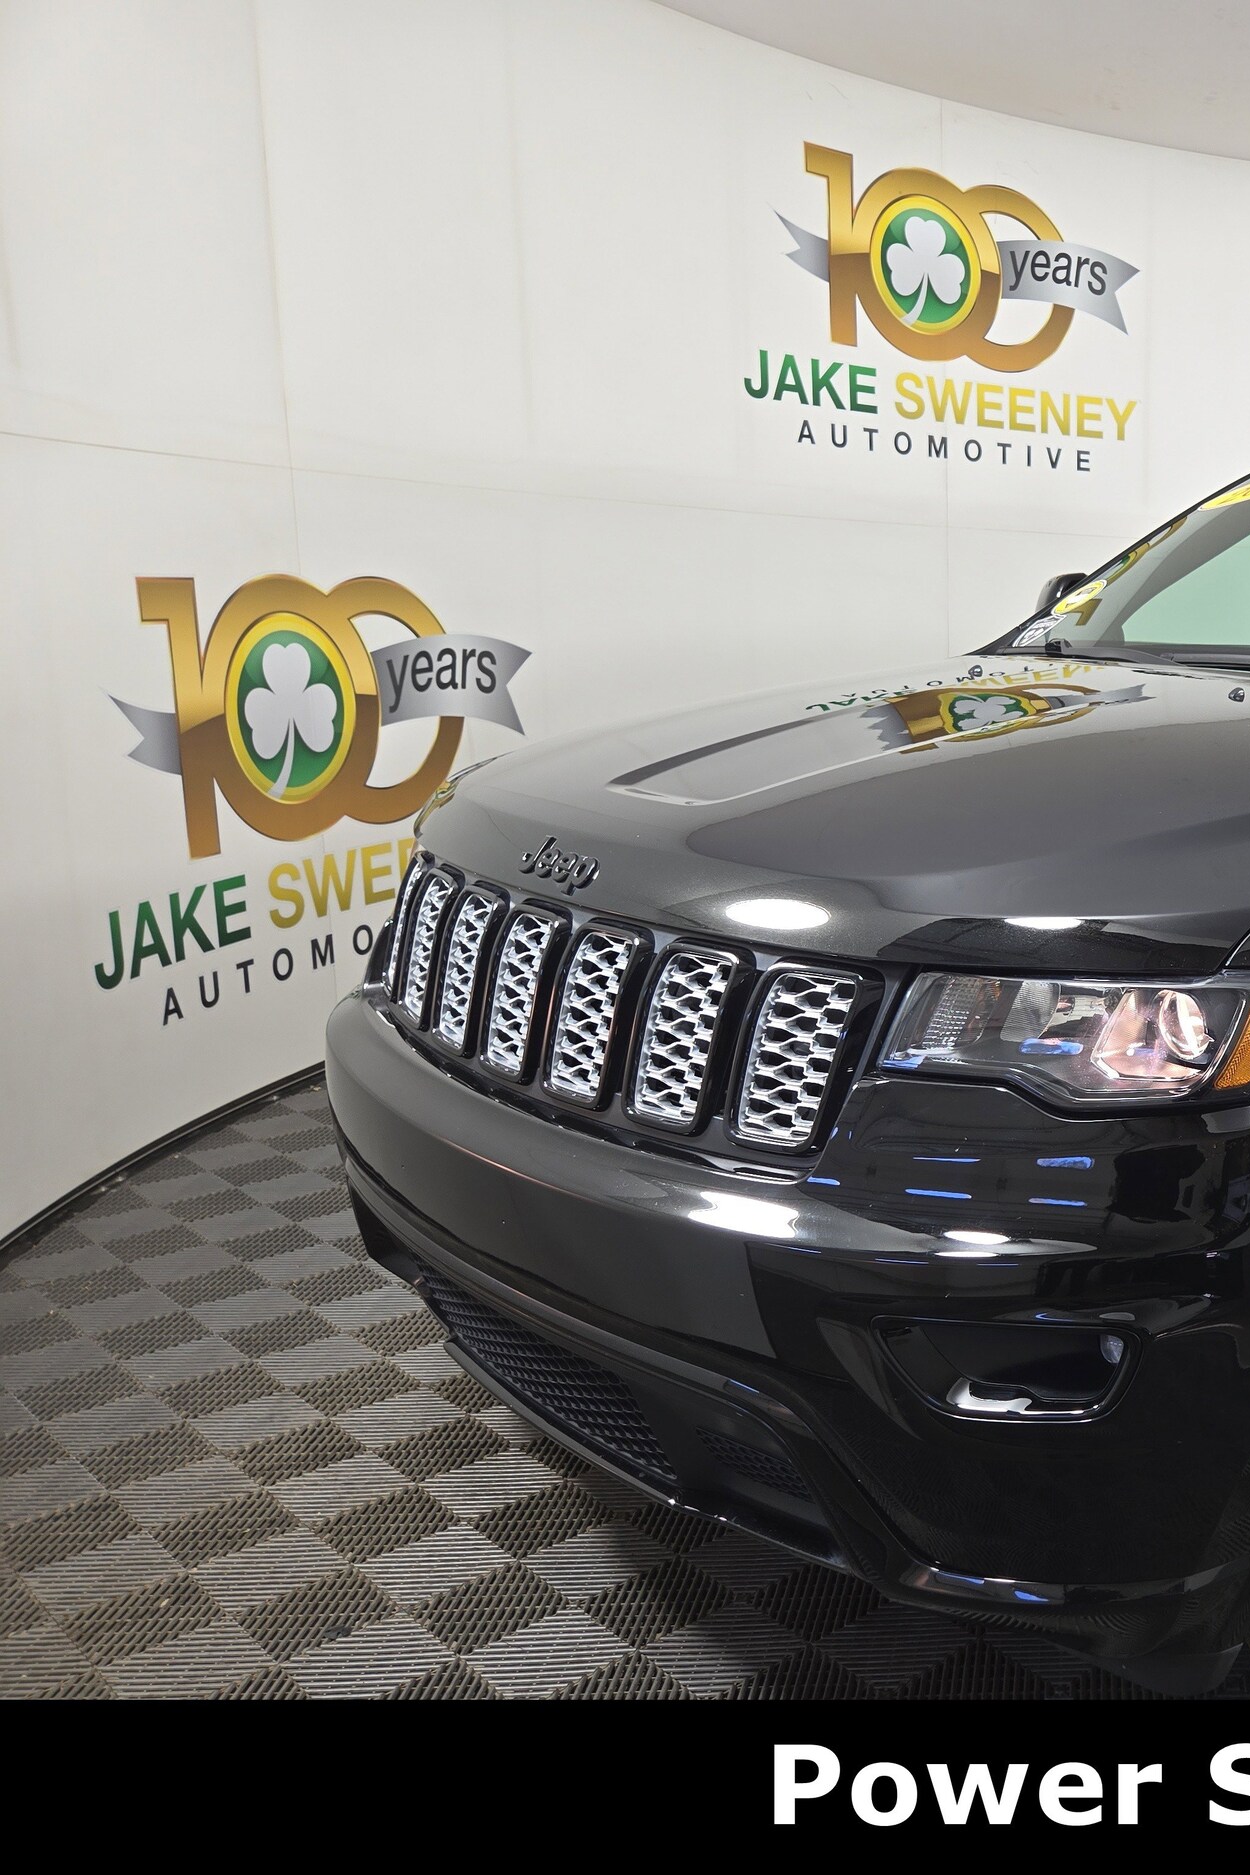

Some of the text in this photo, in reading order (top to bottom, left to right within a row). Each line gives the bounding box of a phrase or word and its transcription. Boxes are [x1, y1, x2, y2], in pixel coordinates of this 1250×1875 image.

[1008, 249, 1109, 297] years
[743, 349, 1138, 442] JAKE SWEENEY
[797, 419, 1092, 473] AUTOMOTIVE
[386, 647, 497, 713] years
[518, 834, 601, 897] Jeep
[93, 874, 252, 991] JAKE
[162, 923, 374, 1027] AUTOMO
